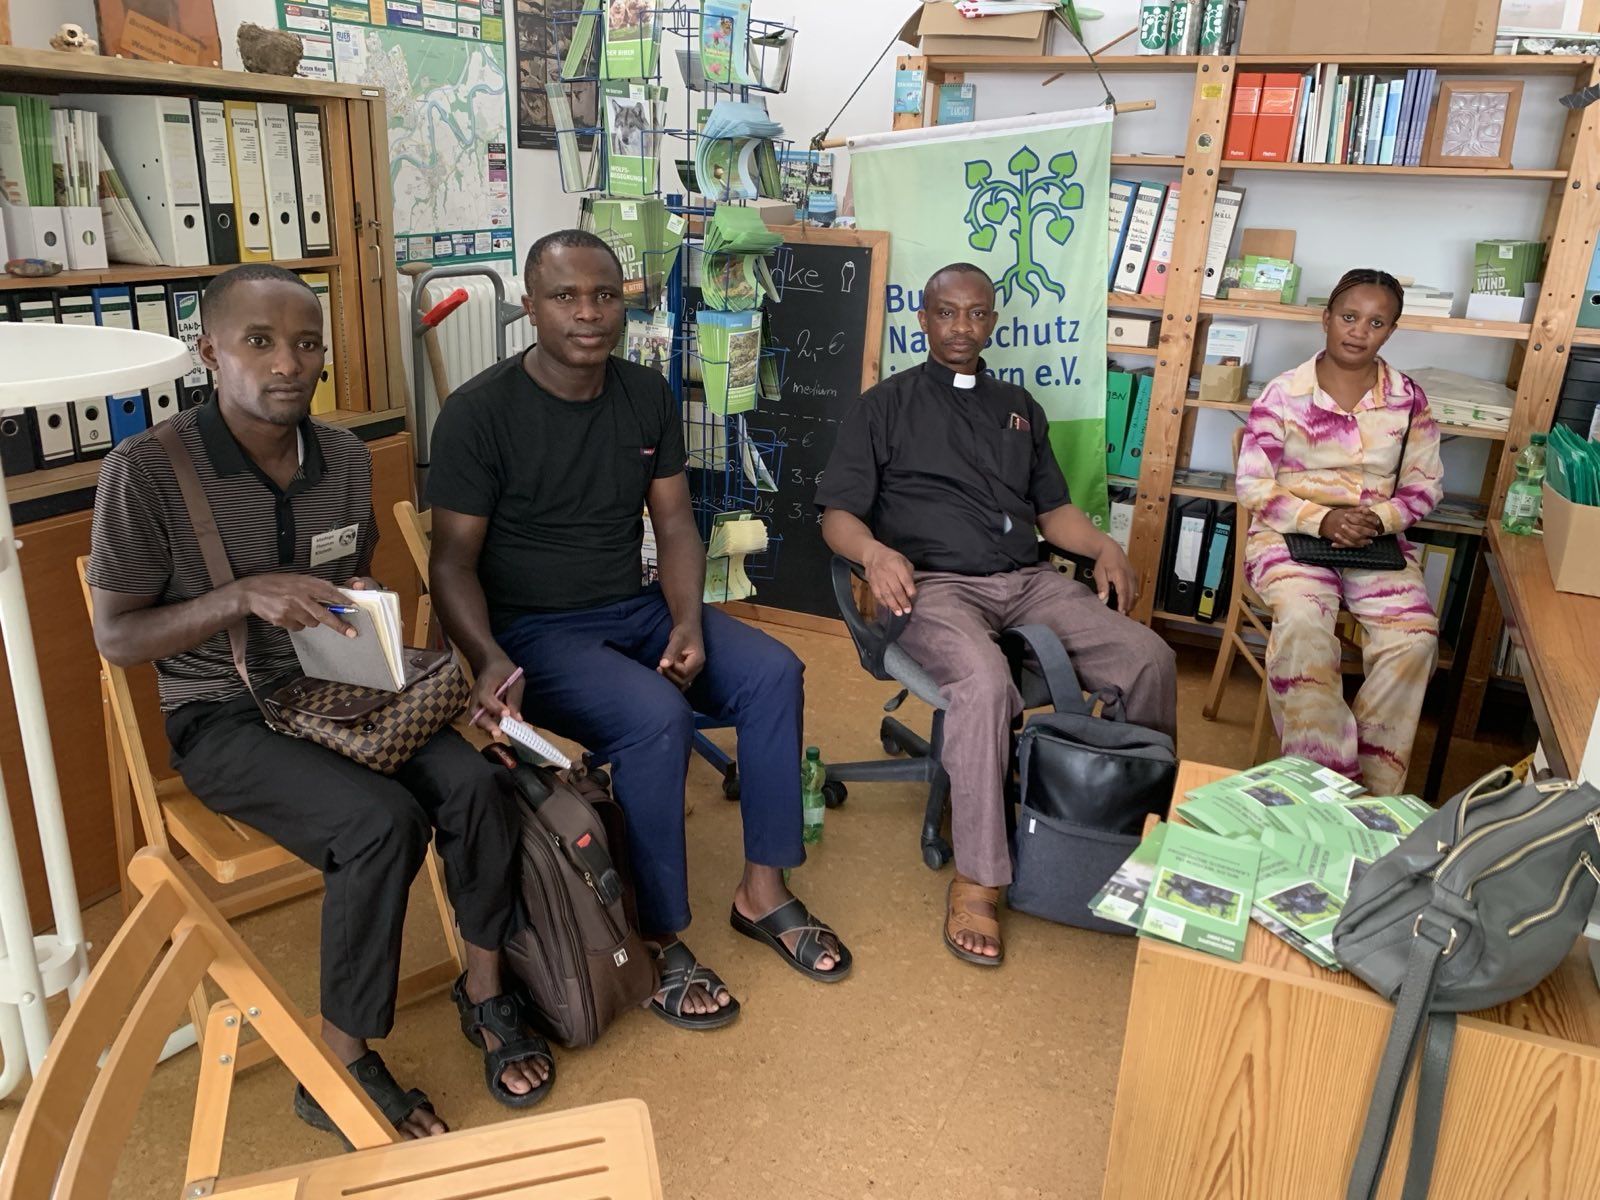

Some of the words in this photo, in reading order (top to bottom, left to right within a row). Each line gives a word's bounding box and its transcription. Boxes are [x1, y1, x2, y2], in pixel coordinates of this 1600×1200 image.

[1477, 276, 1506, 291] WIND
[886, 284, 925, 313] Bu
[1035, 355, 1081, 387] e.V.
[793, 380, 837, 397] medium
